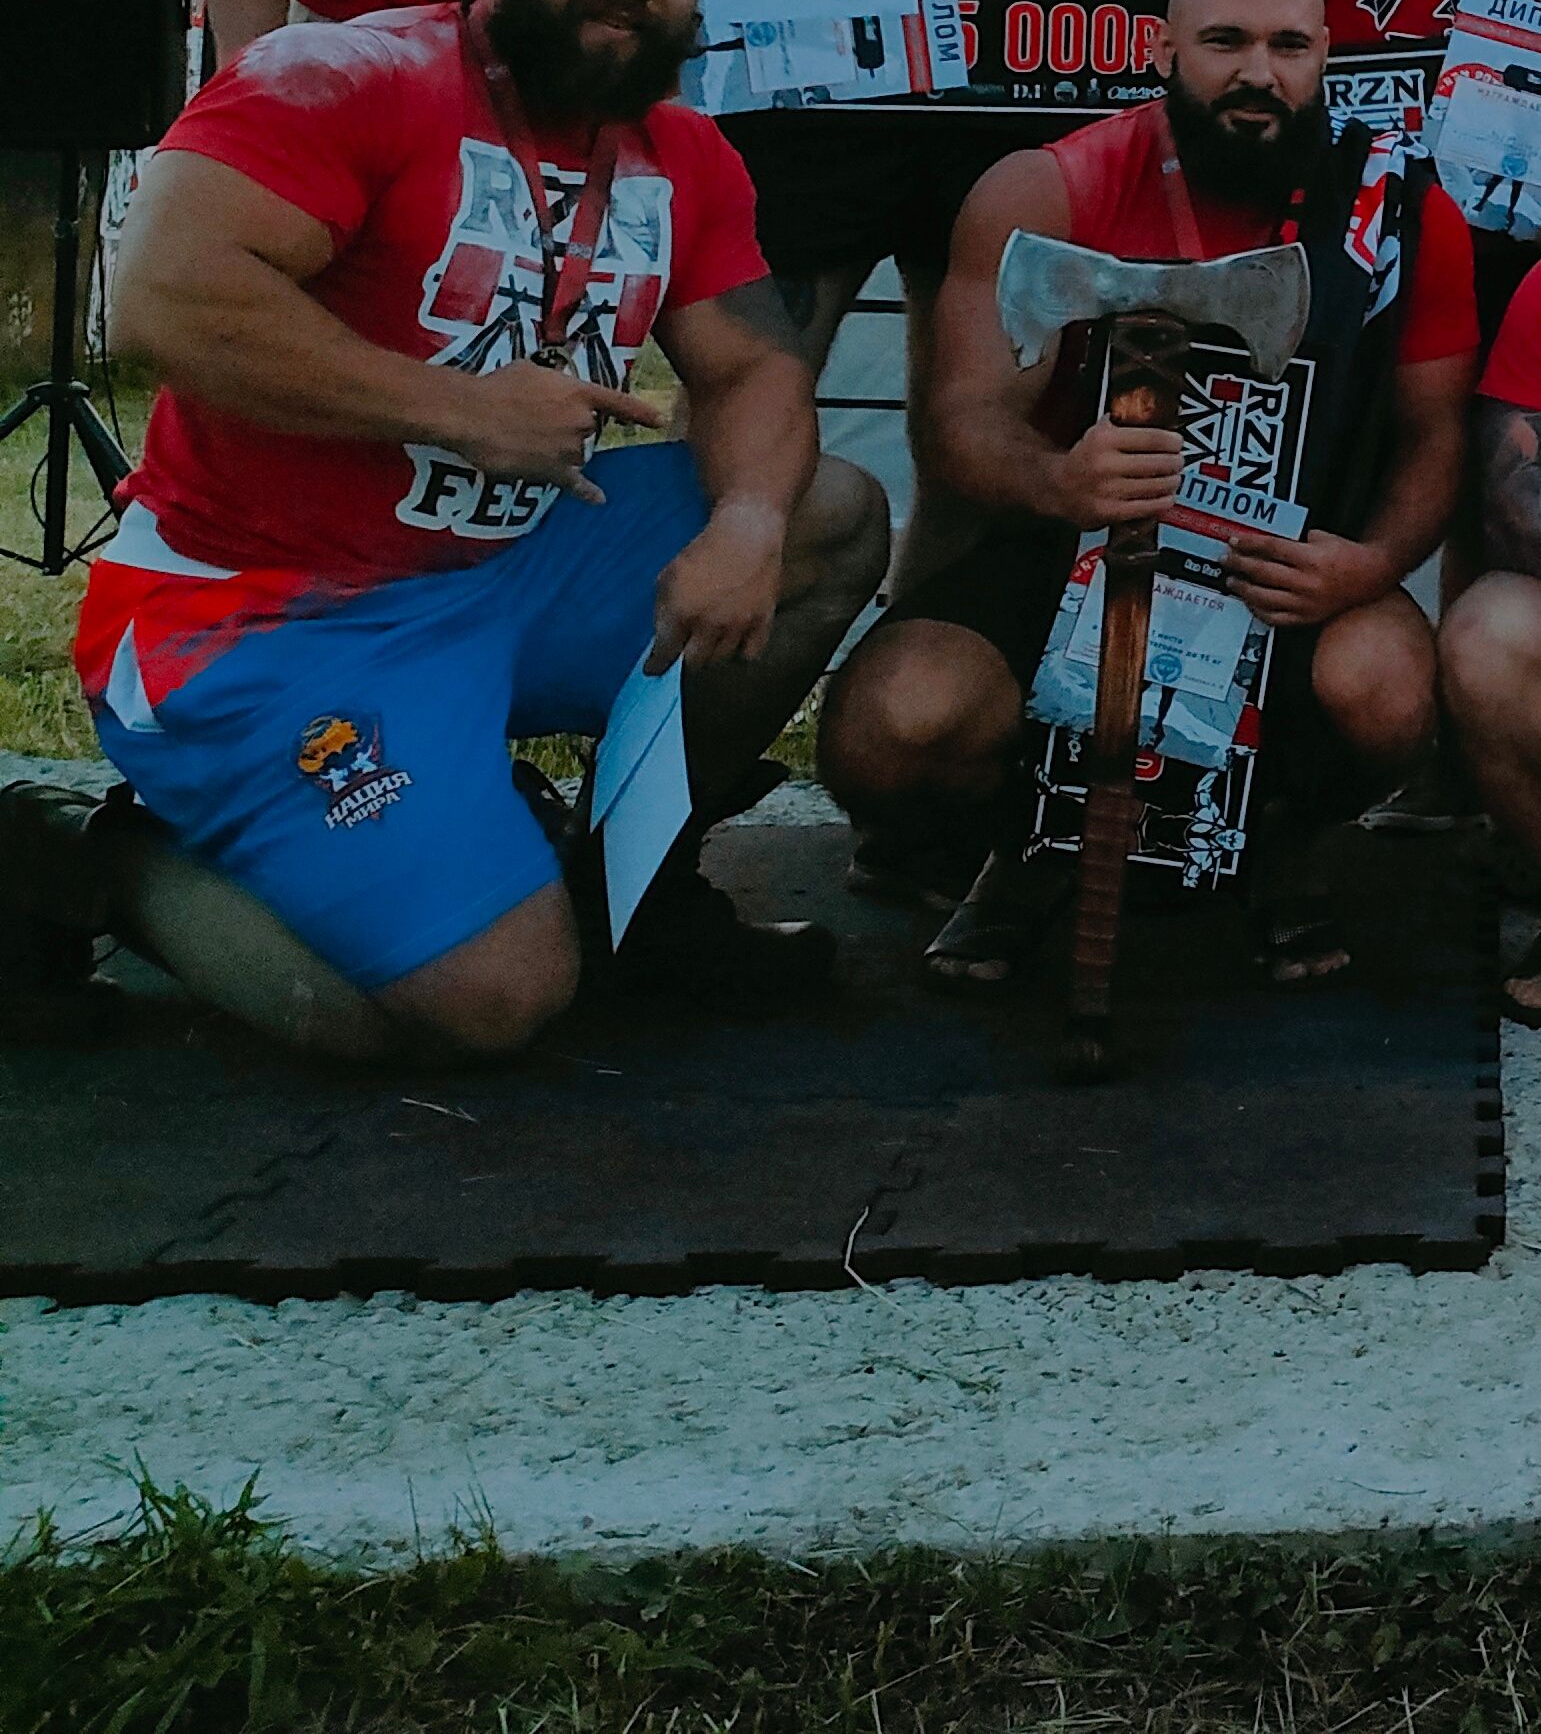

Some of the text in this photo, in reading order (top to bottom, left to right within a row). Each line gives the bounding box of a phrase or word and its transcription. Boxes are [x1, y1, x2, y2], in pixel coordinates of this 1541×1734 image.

[1324, 72, 1423, 109] RZN
[1235, 381, 1285, 496] RZN
[324, 771, 413, 830] НАЦИЯ
[345, 791, 401, 828] МИРА
